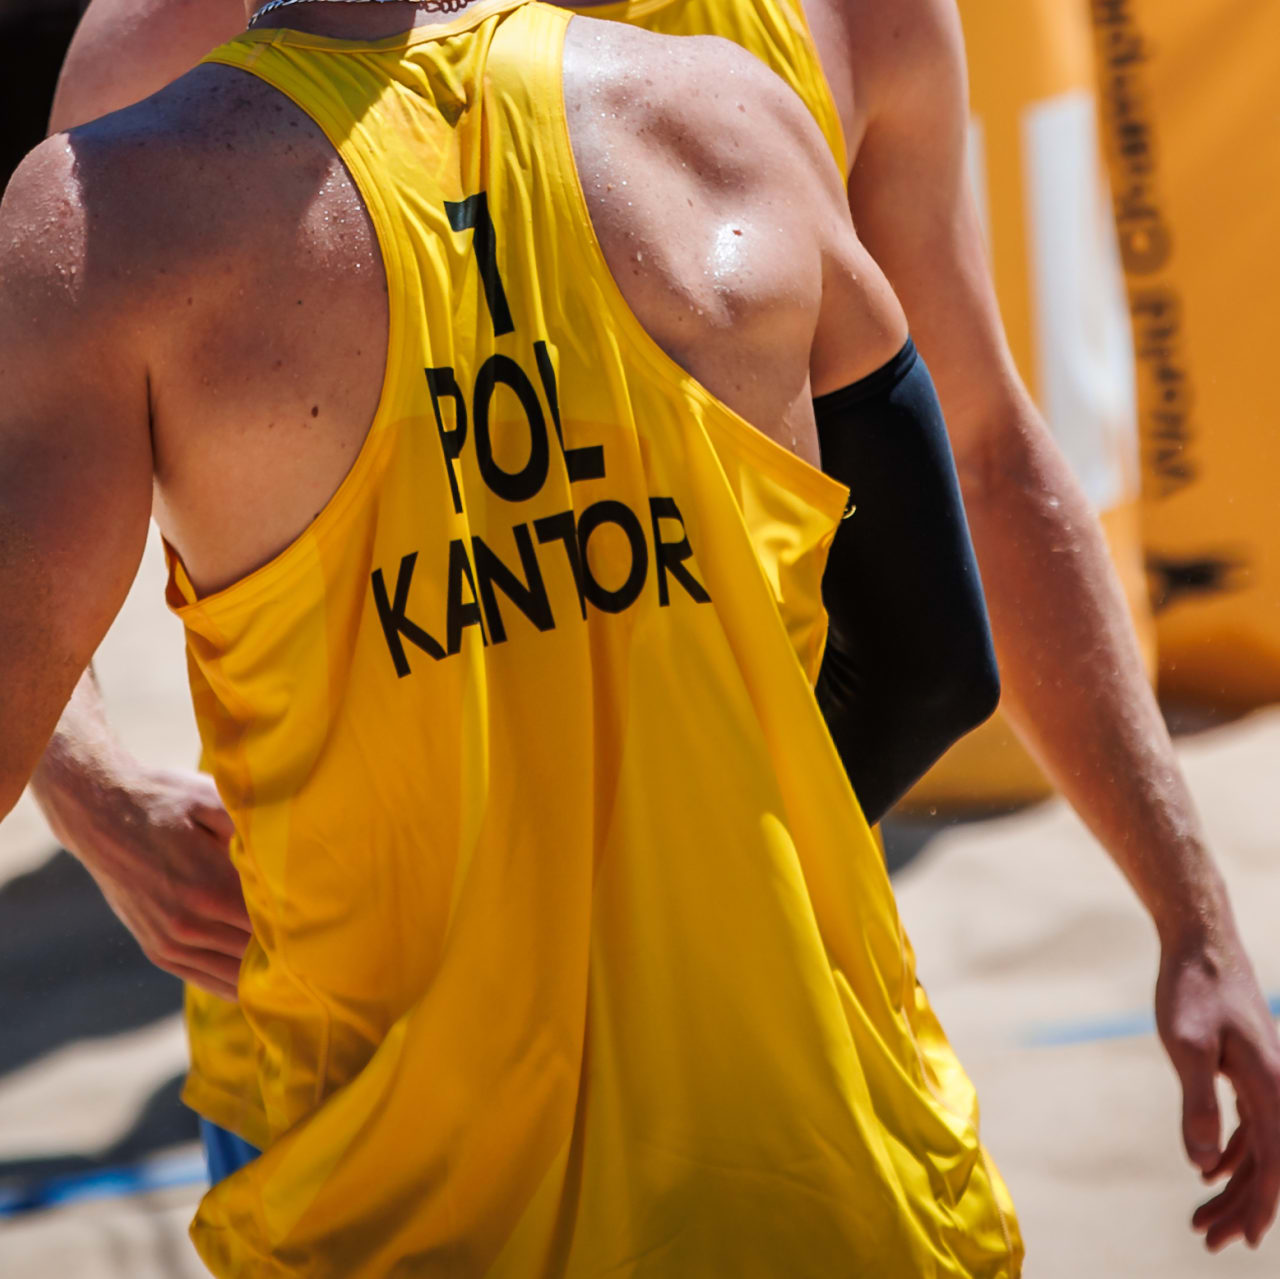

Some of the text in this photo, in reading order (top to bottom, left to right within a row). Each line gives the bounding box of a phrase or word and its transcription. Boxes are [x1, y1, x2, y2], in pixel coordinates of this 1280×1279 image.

[444, 191, 515, 338] 7
[425, 340, 606, 514] POL
[371, 496, 712, 678] KANTOR
